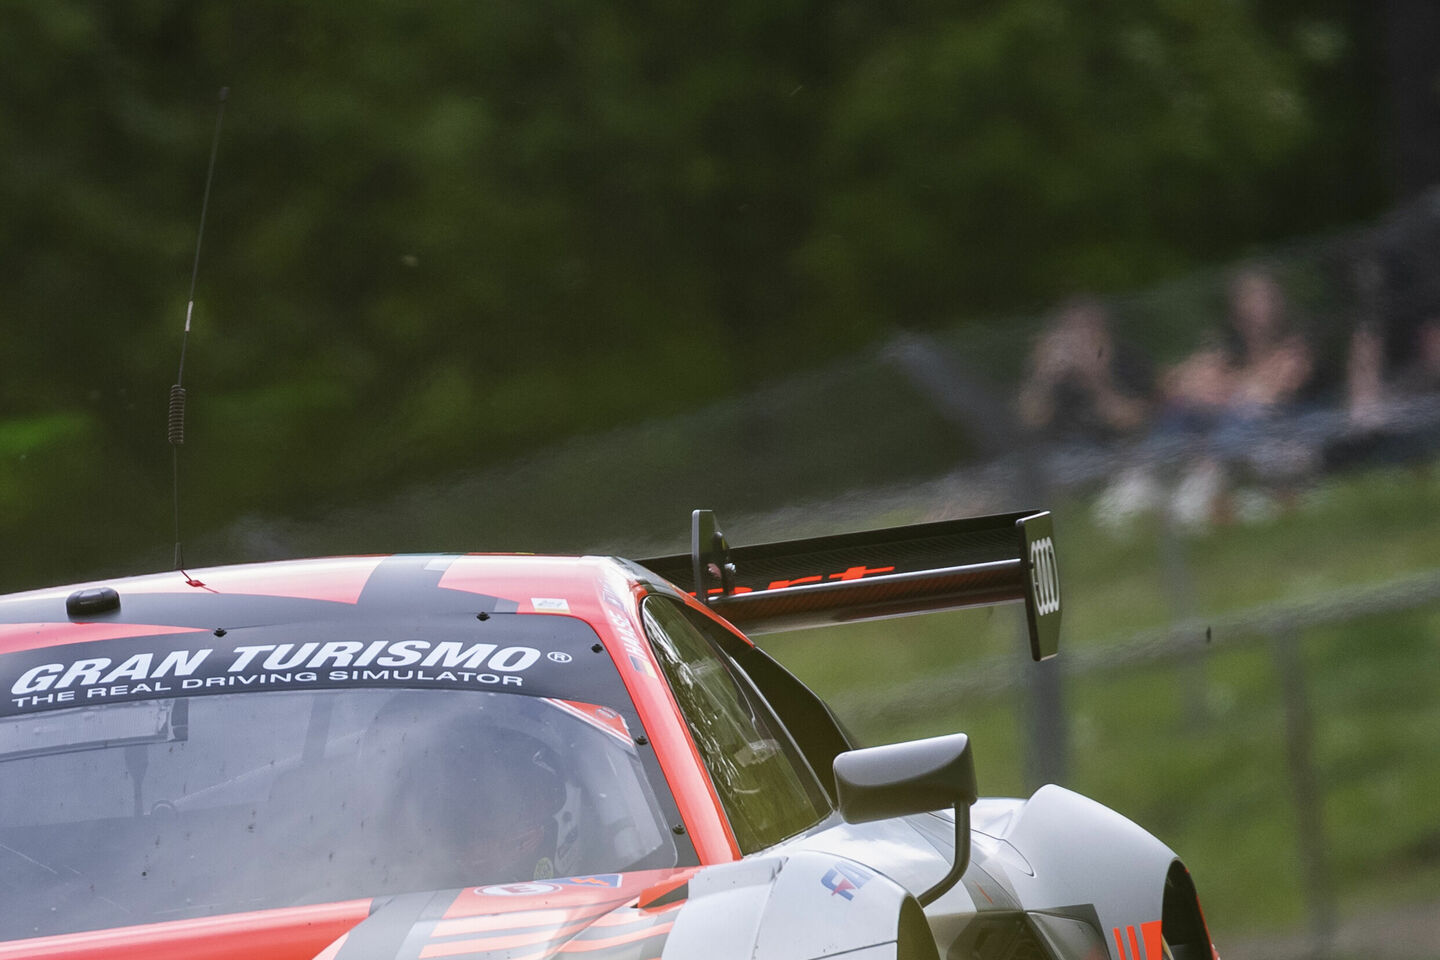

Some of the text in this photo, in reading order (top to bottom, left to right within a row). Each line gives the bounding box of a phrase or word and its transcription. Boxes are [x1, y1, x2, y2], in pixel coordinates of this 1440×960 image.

[11, 640, 541, 694] GRAN TURISMO
[12, 670, 523, 708] THE REAL DRIVING SIMULATOR
